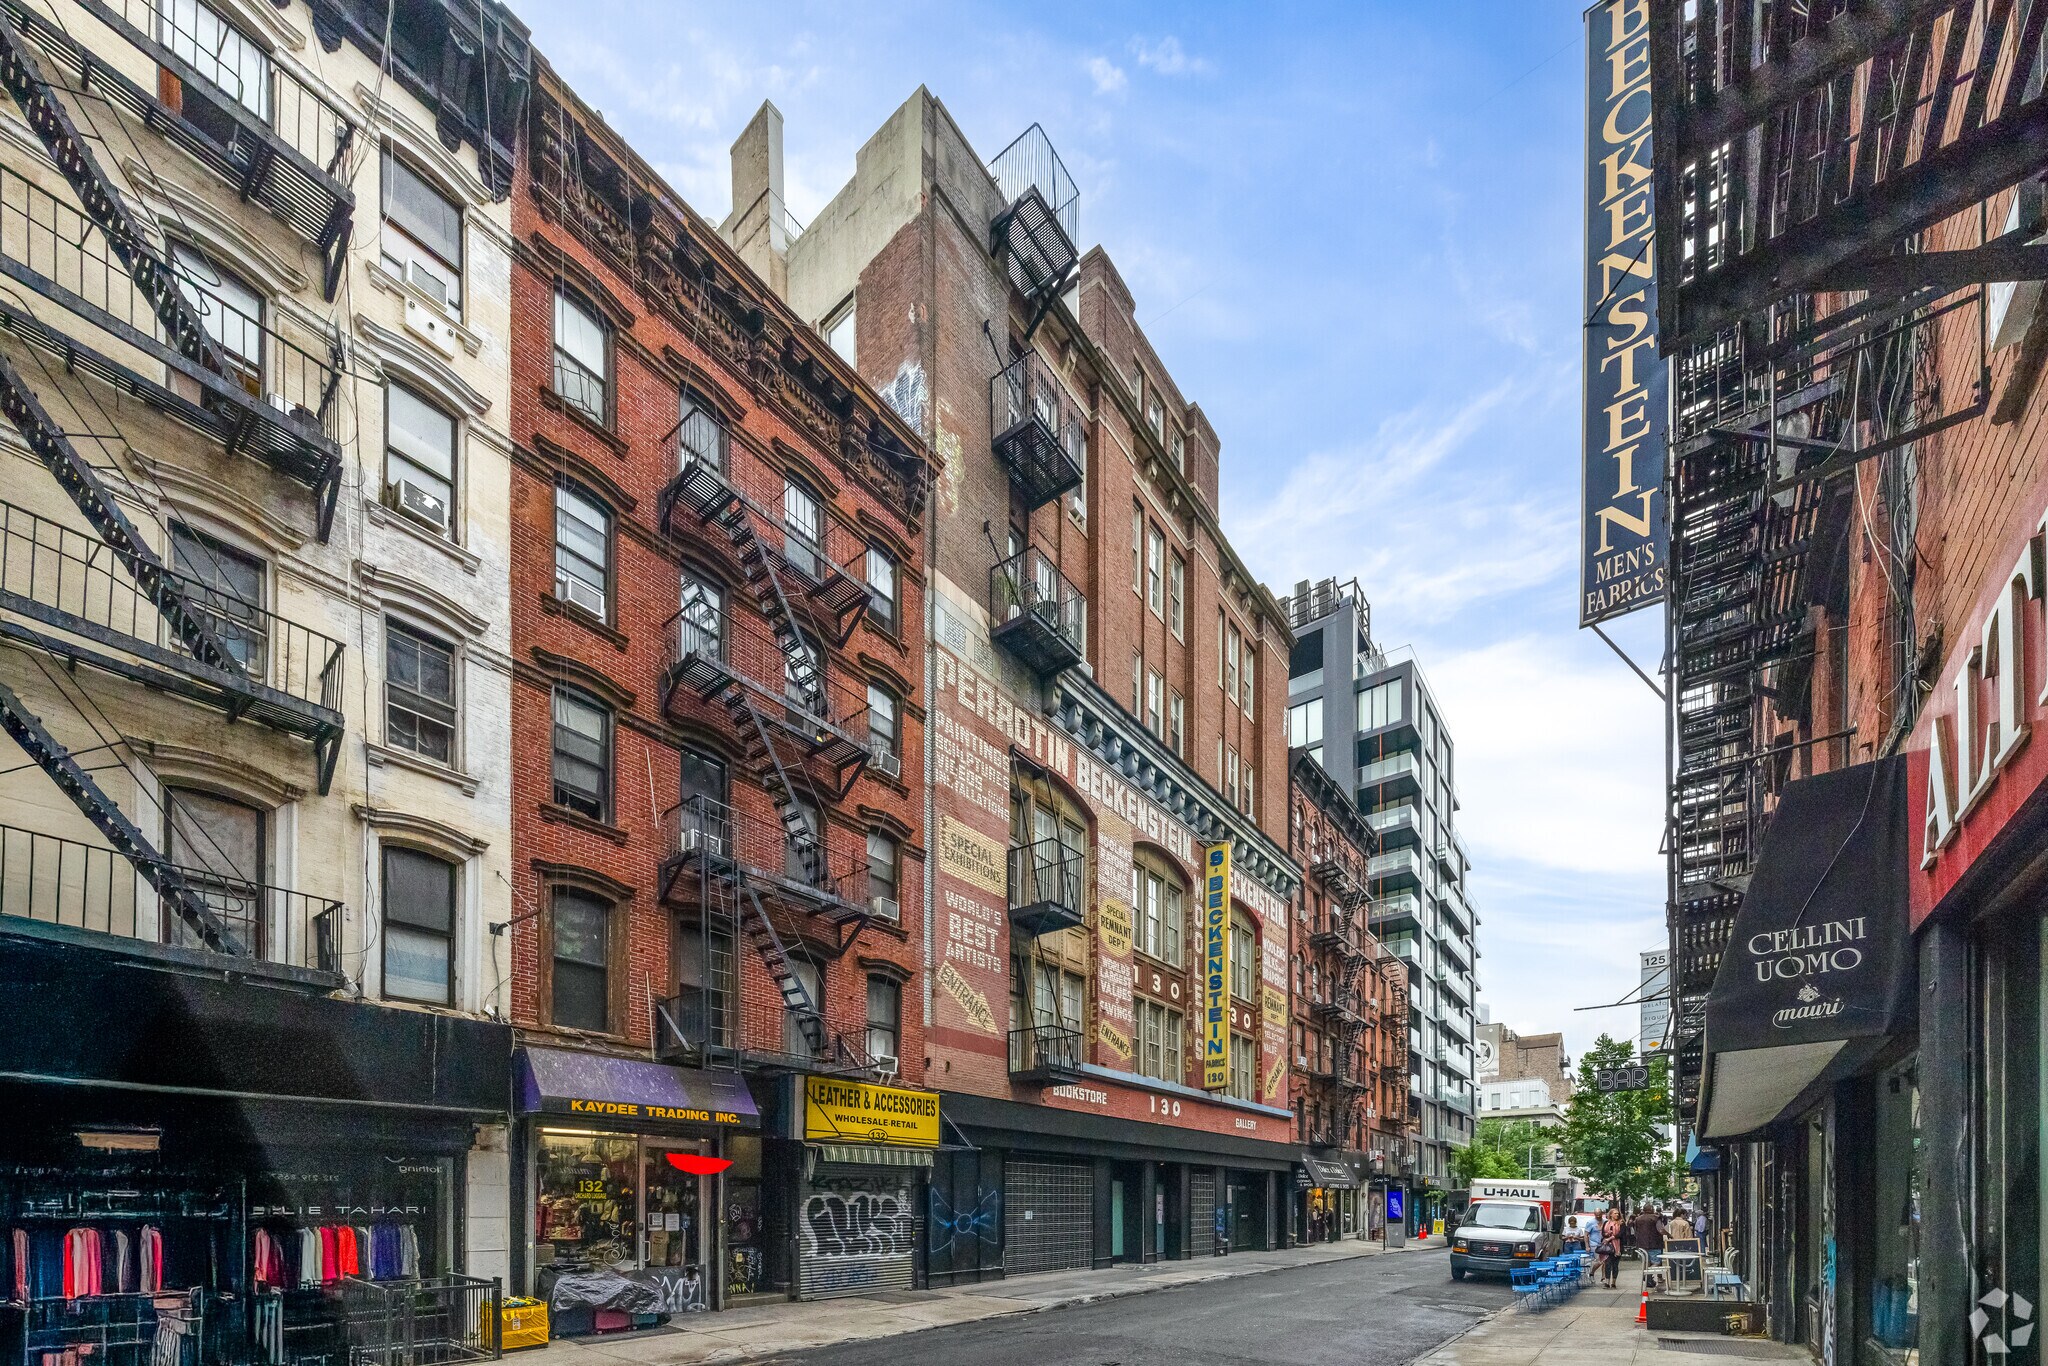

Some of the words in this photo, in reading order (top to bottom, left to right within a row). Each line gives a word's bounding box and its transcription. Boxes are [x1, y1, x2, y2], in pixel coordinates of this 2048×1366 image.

[1594, 0, 1657, 556] BECKENSTEIN
[1596, 542, 1654, 584] MEN'S
[1586, 568, 1664, 615] FABRICS
[935, 645, 1070, 778] PERROTIN
[1076, 751, 1192, 863] BECKENSTEIN
[936, 710, 1010, 773] PAINTINGS
[936, 732, 1010, 791] SCULPTURES
[936, 752, 983, 792] VIDEOS
[944, 845, 1001, 883] EXHIBITIONS
[950, 833, 994, 867] SPECIAL
[945, 890, 1002, 926] WORLD'S
[1106, 904, 1126, 922] SPECIAL
[949, 912, 999, 953] BEST
[1101, 915, 1131, 940] REMNANT
[1748, 917, 1867, 955] CELLINI
[945, 940, 1002, 974] ARTISTS
[1208, 875, 1224, 1055] BECKENSTEIN
[1263, 938, 1285, 962] WOOLENS
[1644, 955, 1666, 966] 125
[1755, 947, 1862, 982] UOMO
[1194, 874, 1204, 1060] WOOLENS
[1263, 967, 1287, 990] DRAPERIES
[1100, 980, 1132, 1002] VALUES
[1264, 995, 1285, 1016] REMNANT
[1643, 1001, 1667, 1009] GELATO
[1100, 1001, 1132, 1022] SAVINGS
[1644, 1014, 1666, 1022] PIQUE
[1773, 998, 1845, 1028] mauri
[1101, 1024, 1130, 1057] ENTRANCE
[1266, 1060, 1285, 1095] ENTRANCE
[1600, 1067, 1648, 1091] BAR
[812, 1084, 861, 1109] LEATHER
[863, 1091, 871, 1109] &
[874, 1093, 936, 1117] ACCESSORIES
[1053, 1085, 1108, 1105] BOOKSTORE
[1150, 1095, 1181, 1118] 130
[571, 1100, 638, 1116] KAYDEE
[645, 1106, 710, 1122] TRADING
[715, 1112, 741, 1124] INC.
[1235, 1118, 1257, 1131] GALLERY
[870, 1132, 886, 1141] 132
[578, 1180, 604, 1193] 132
[1484, 1187, 1540, 1198] U-HAUL
[335, 1206, 427, 1214] TAHARI
